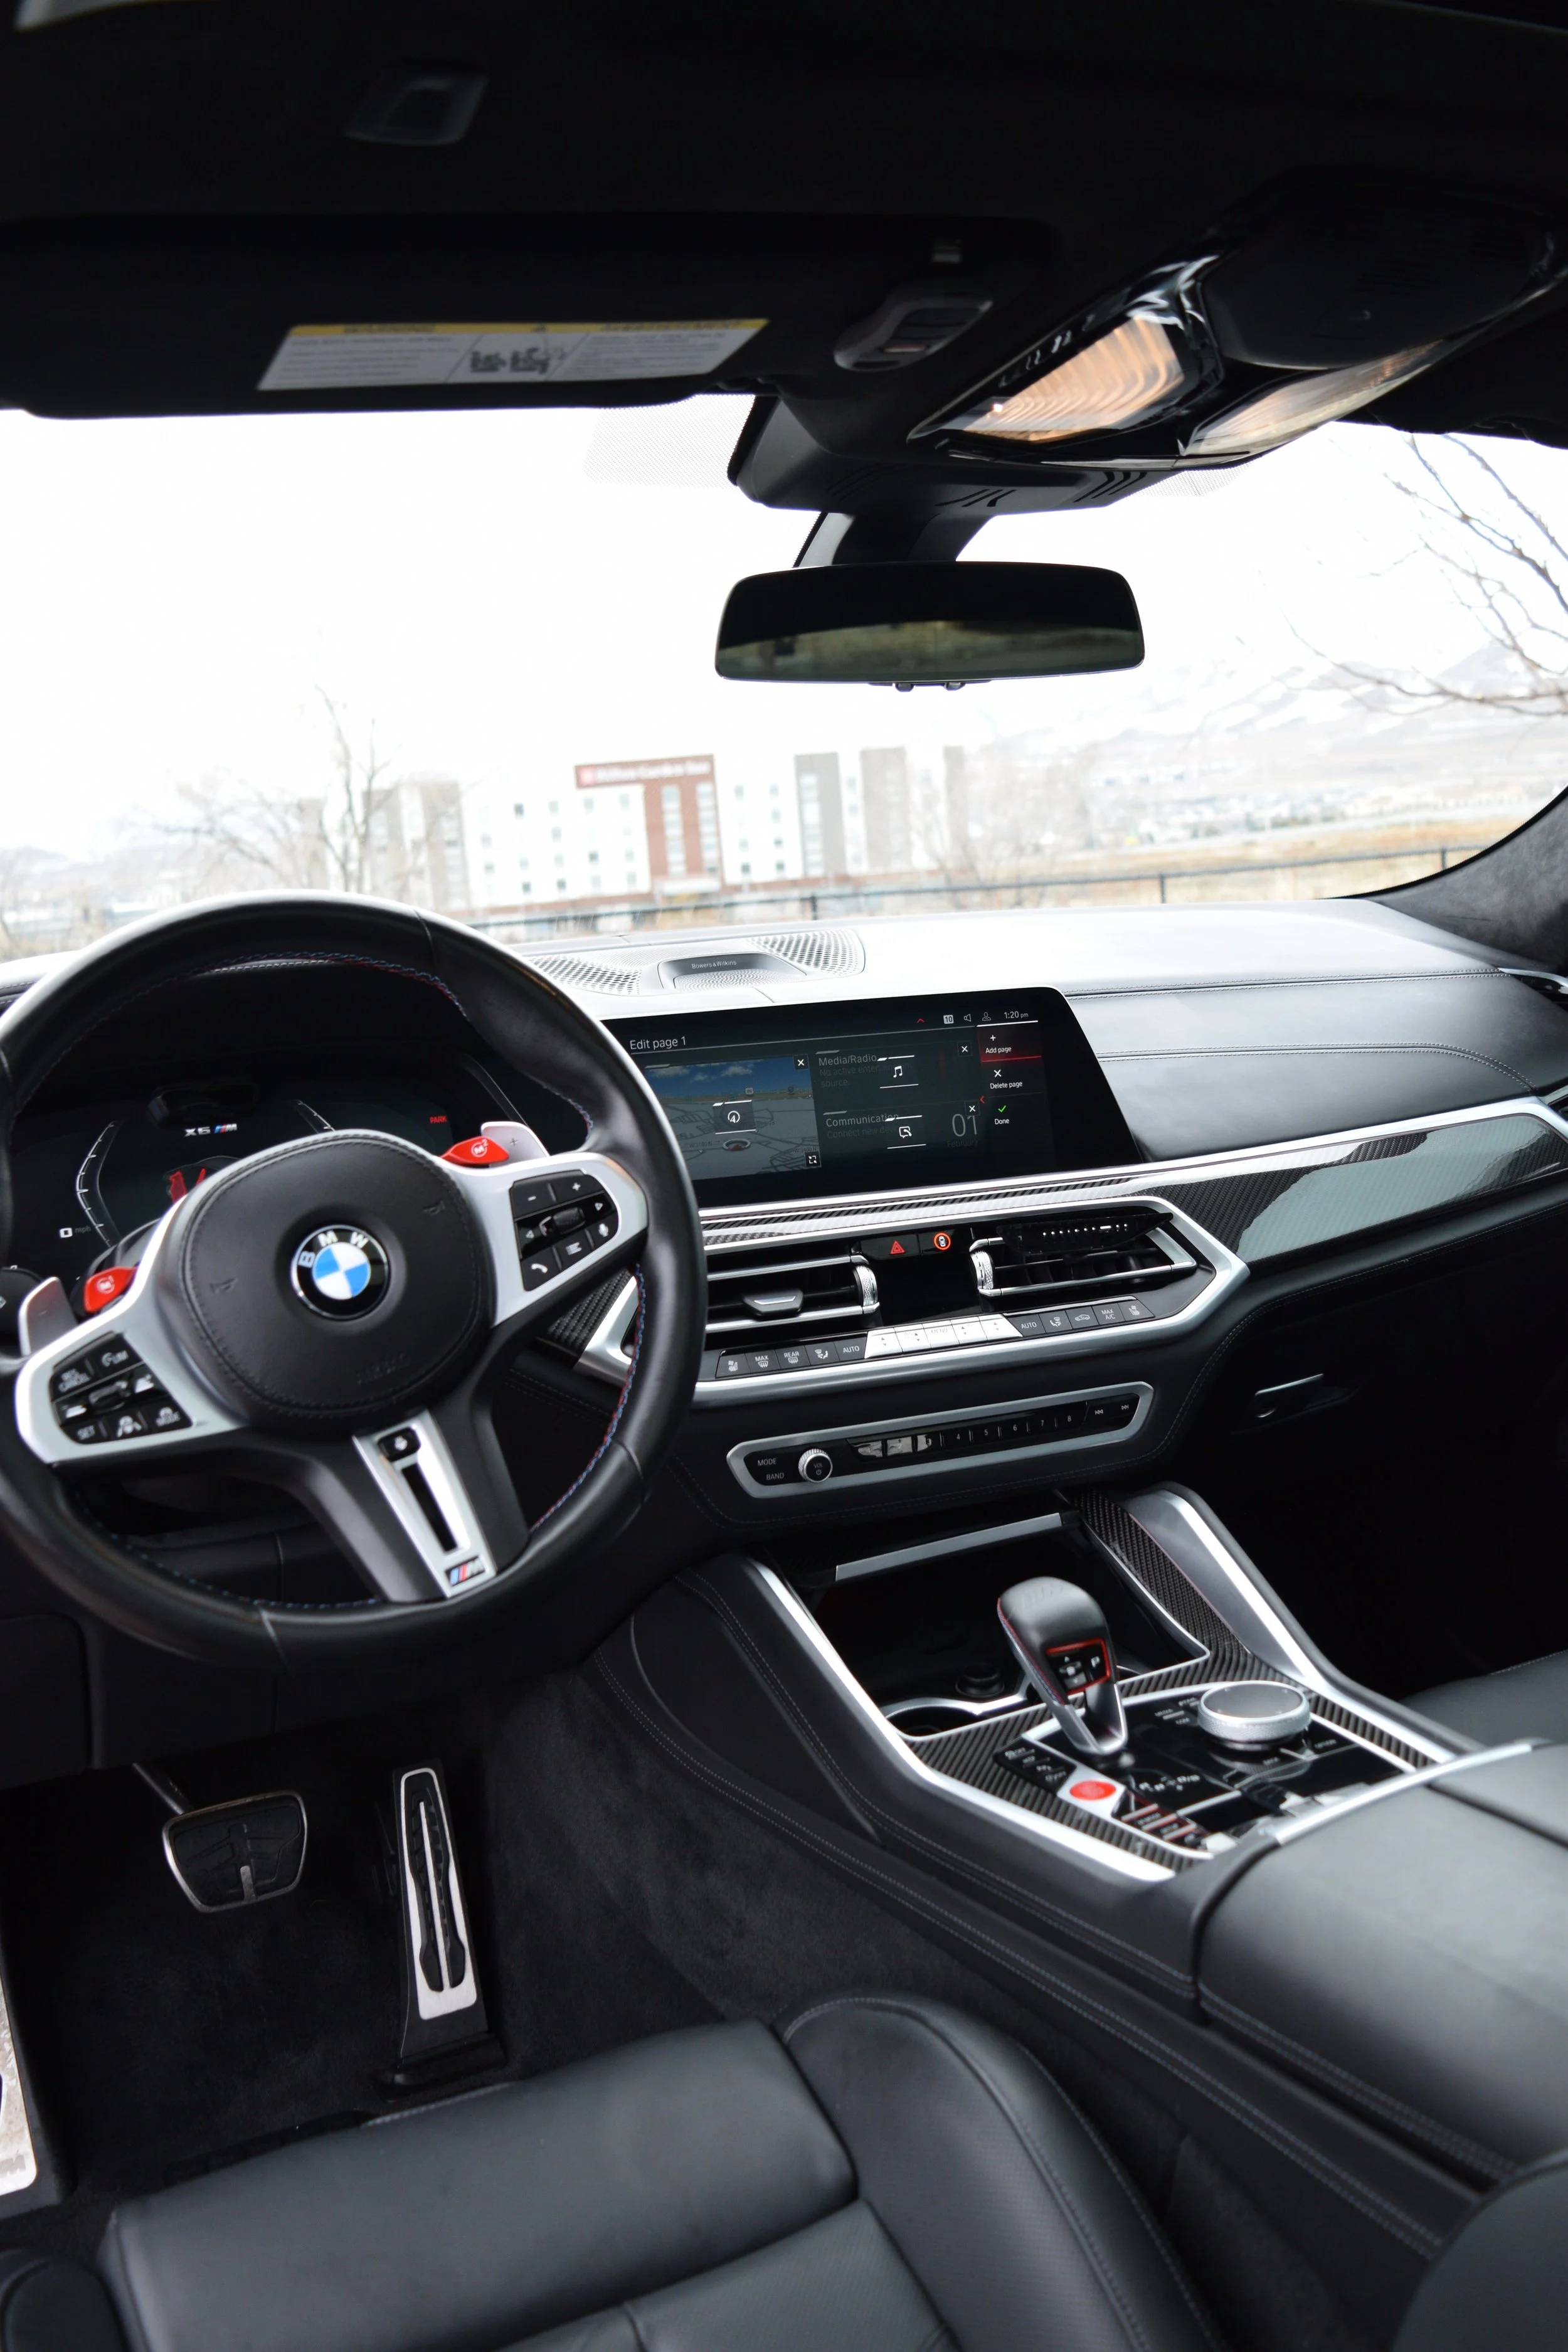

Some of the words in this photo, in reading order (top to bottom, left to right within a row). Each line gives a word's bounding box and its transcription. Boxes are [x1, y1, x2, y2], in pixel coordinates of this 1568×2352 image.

[630, 1039, 650, 1050] Edit
[653, 1039, 678, 1050] page
[681, 1036, 686, 1046] 1
[818, 1054, 877, 1066] Media/Radio
[429, 1115, 447, 1123] PARK
[952, 1113, 977, 1136] 01
[184, 1126, 211, 1136] X6
[298, 1230, 369, 1268] BMW
[757, 1458, 777, 1466] MODE
[766, 1473, 785, 1481] BAND
[1091, 1656, 1100, 1667] P
